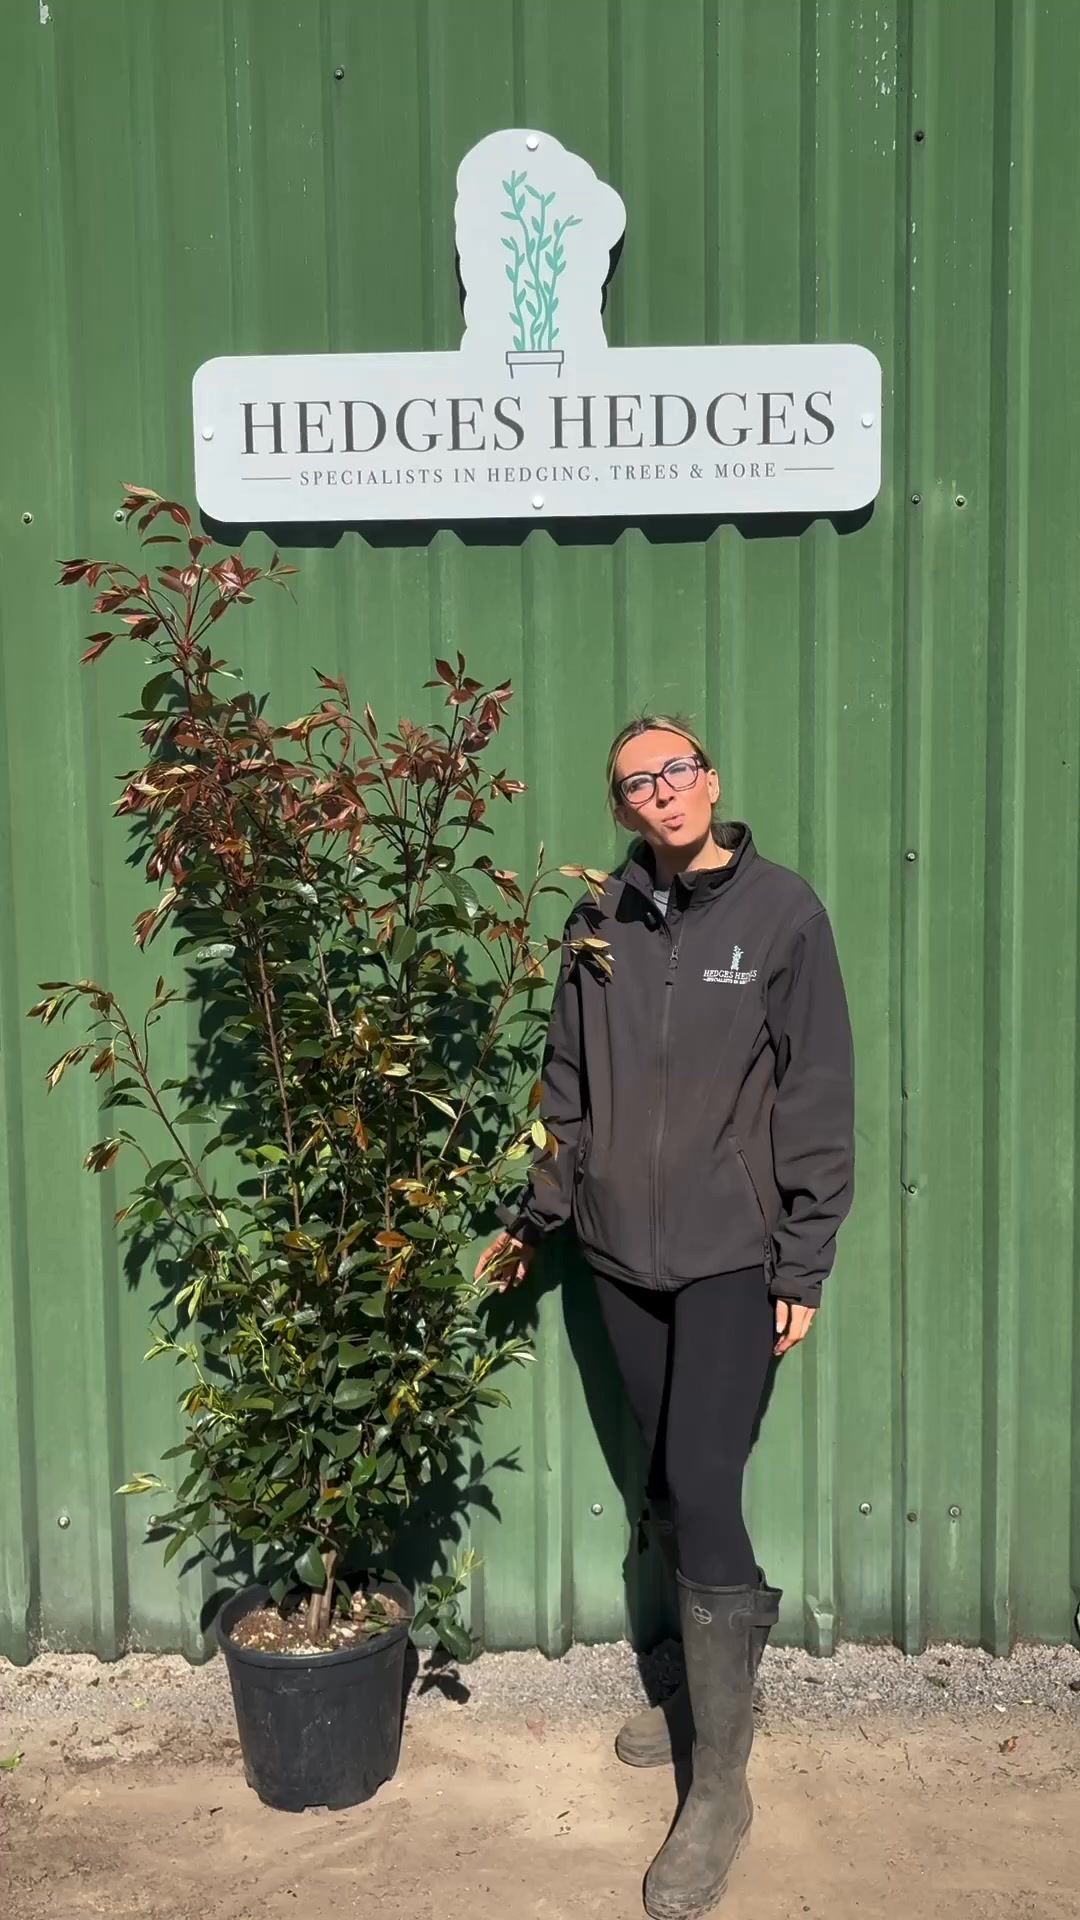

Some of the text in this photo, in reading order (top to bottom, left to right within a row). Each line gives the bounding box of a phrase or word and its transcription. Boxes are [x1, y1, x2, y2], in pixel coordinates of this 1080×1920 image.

[240, 391, 835, 455] HEDGES HEDGES
[300, 462, 777, 486] SPECIALISTS IN HEDGING, TREES & MORE
[704, 970, 734, 978] HEDGES
